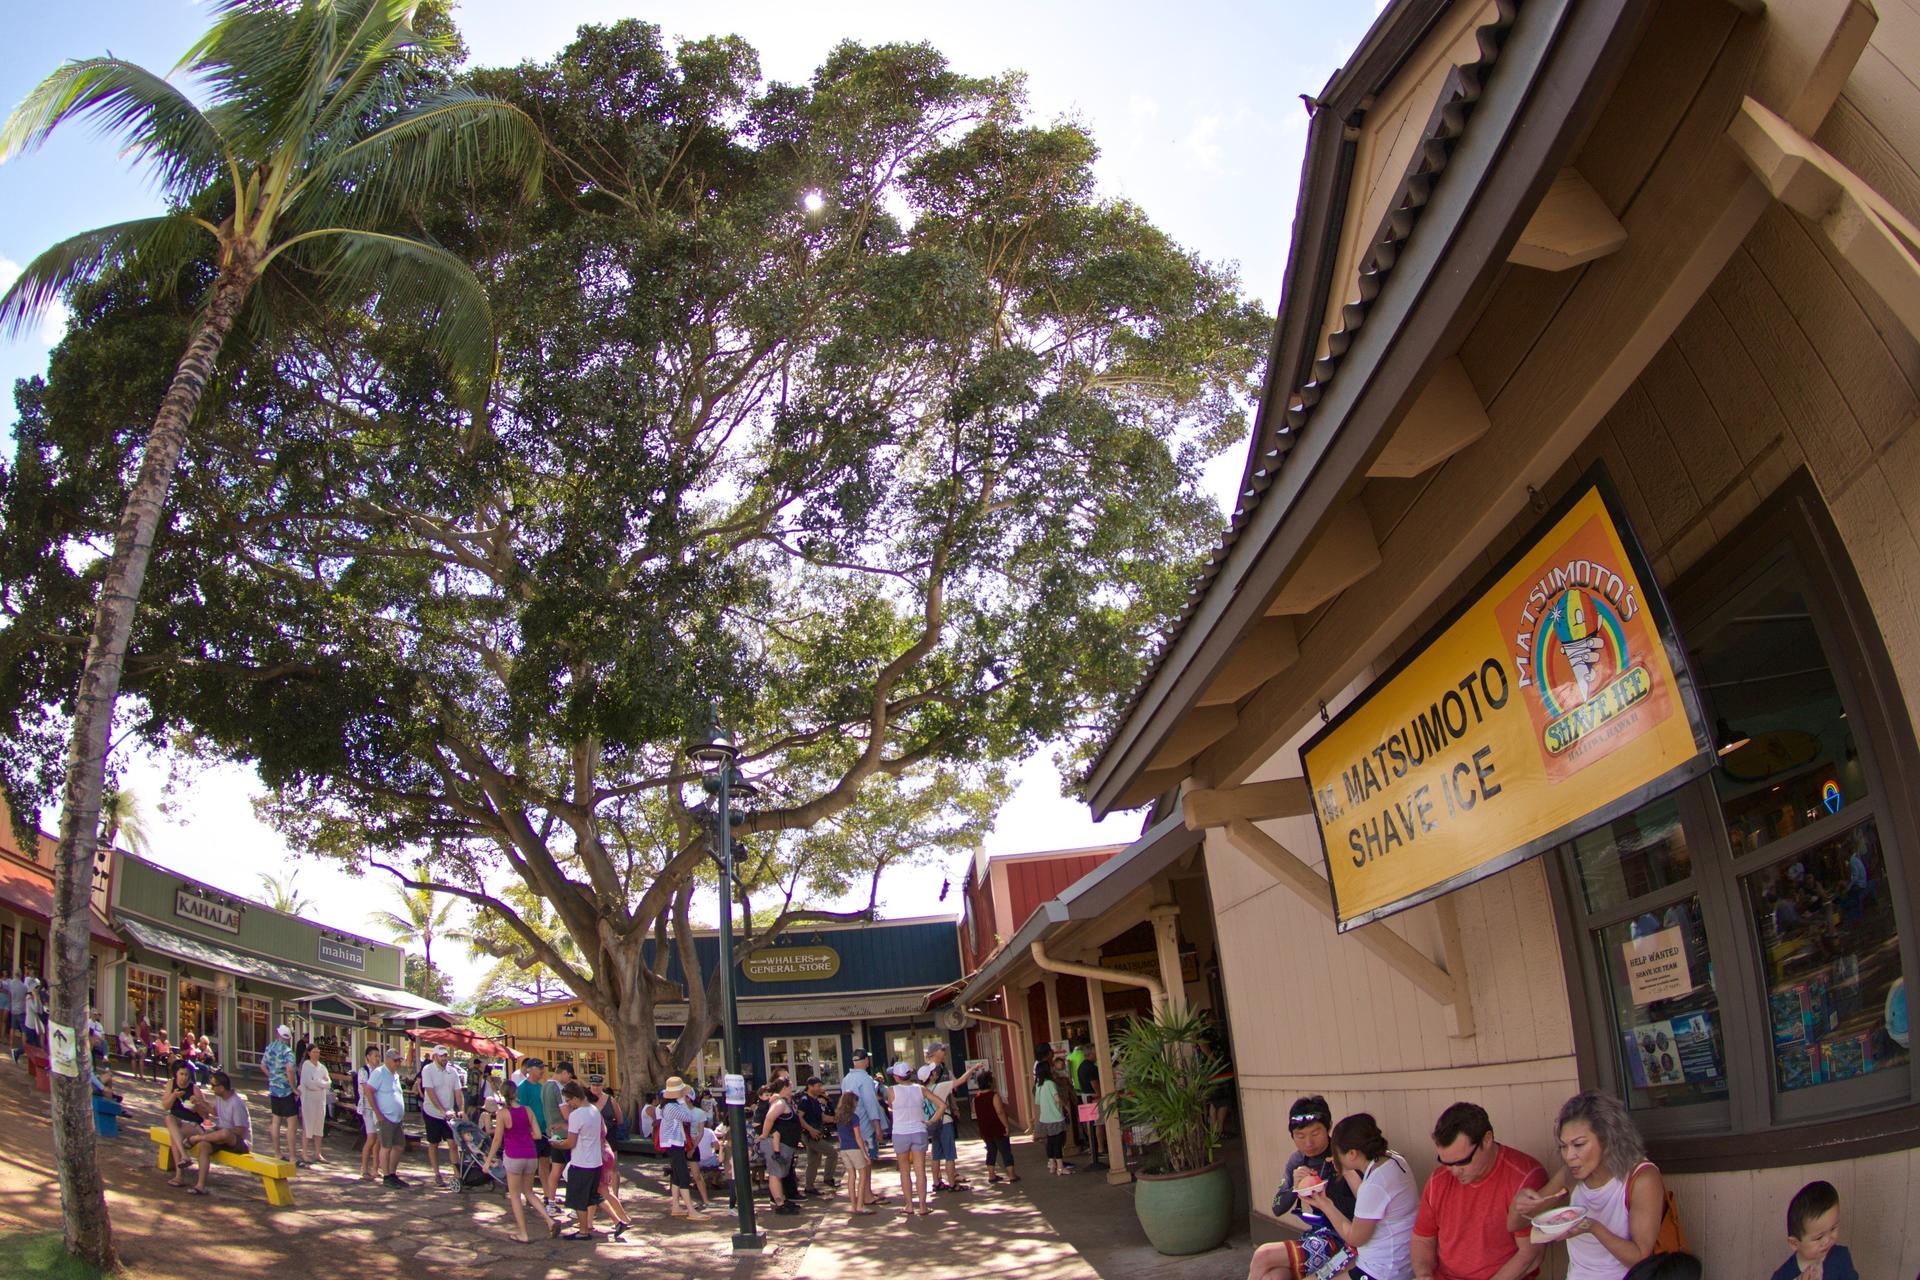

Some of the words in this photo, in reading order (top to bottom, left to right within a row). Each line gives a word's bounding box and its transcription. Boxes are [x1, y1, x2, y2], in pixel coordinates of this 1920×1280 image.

[1515, 559, 1640, 689] MATSUMOTO'S
[1547, 700, 1614, 752] SHAVE
[1610, 669, 1648, 713] ICE
[1341, 657, 1509, 810] MATSUMOTO
[1348, 783, 1440, 868] SHAVE
[1440, 744, 1502, 818] ICE
[179, 896, 233, 928] KAHALA
[322, 945, 362, 964] mahina
[750, 965, 795, 974] GENERAL
[798, 962, 832, 972] STORE
[766, 954, 815, 965] WHALERS
[1629, 955, 1647, 967] HELP
[1648, 946, 1679, 962] WANTED
